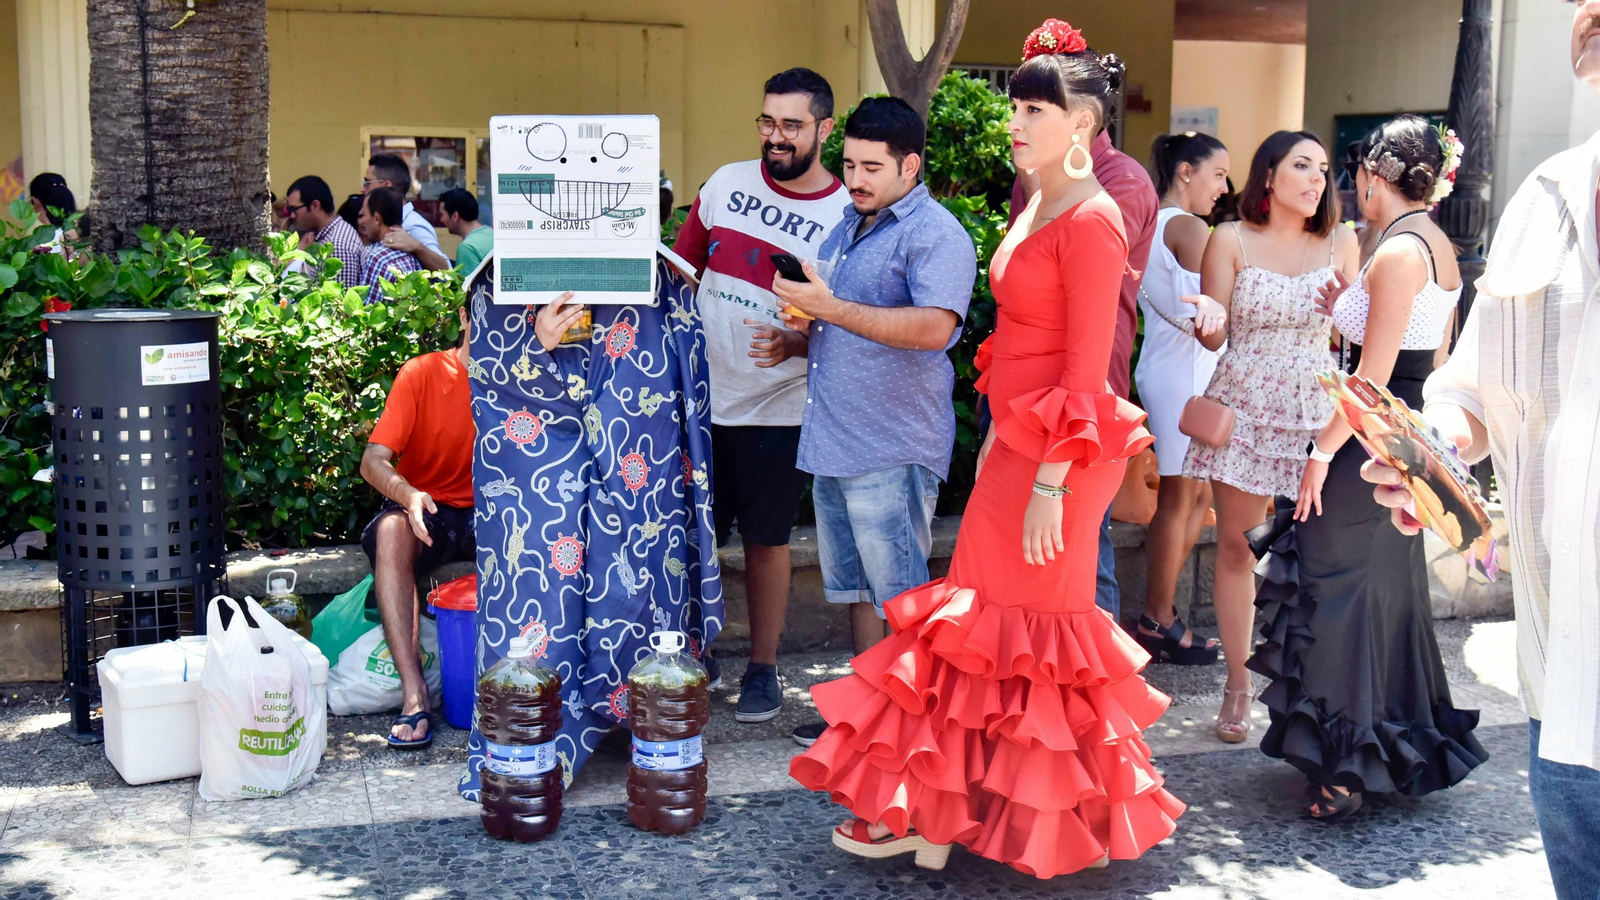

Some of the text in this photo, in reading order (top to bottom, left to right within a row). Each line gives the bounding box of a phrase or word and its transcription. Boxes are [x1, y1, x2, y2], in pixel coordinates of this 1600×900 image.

[727, 191, 824, 244] SPORT
[540, 220, 590, 230] STAYCRISP
[611, 221, 636, 231] McCain
[167, 349, 207, 359] amisando
[264, 690, 288, 700] Entre
[242, 785, 268, 795] BOLSA
